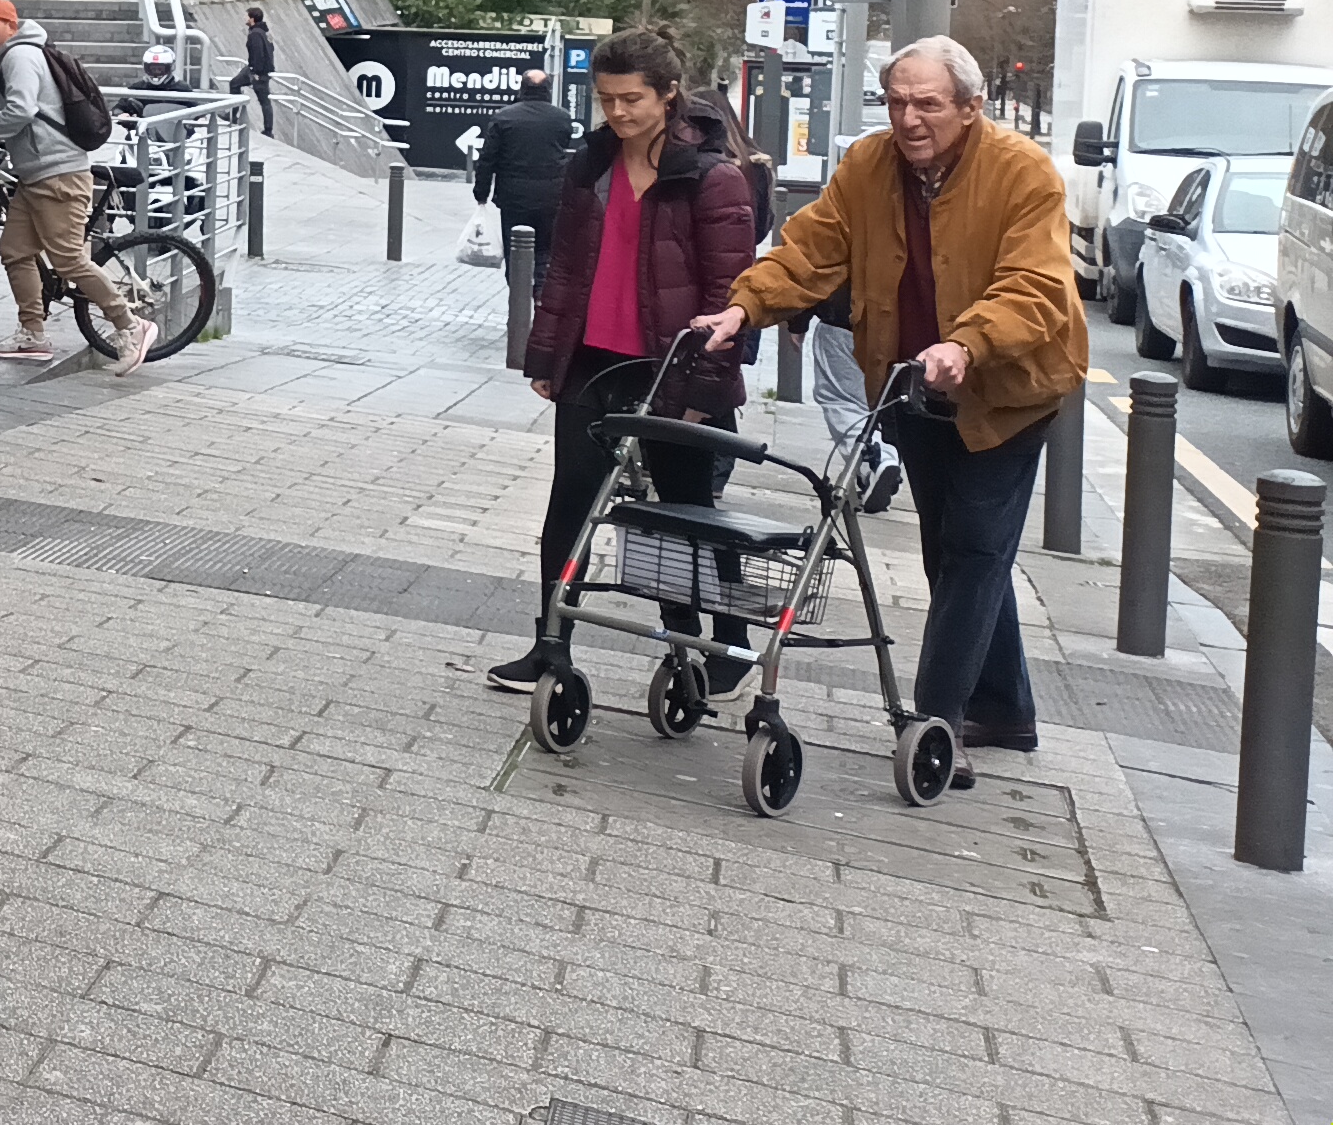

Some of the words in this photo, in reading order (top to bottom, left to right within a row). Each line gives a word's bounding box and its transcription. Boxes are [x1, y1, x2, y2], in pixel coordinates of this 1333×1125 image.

[441, 48, 479, 58] CENTRO
[479, 50, 531, 59] COMERCIAL
[570, 49, 586, 67] P
[426, 65, 523, 91] Mendib
[475, 93, 516, 102] comer
